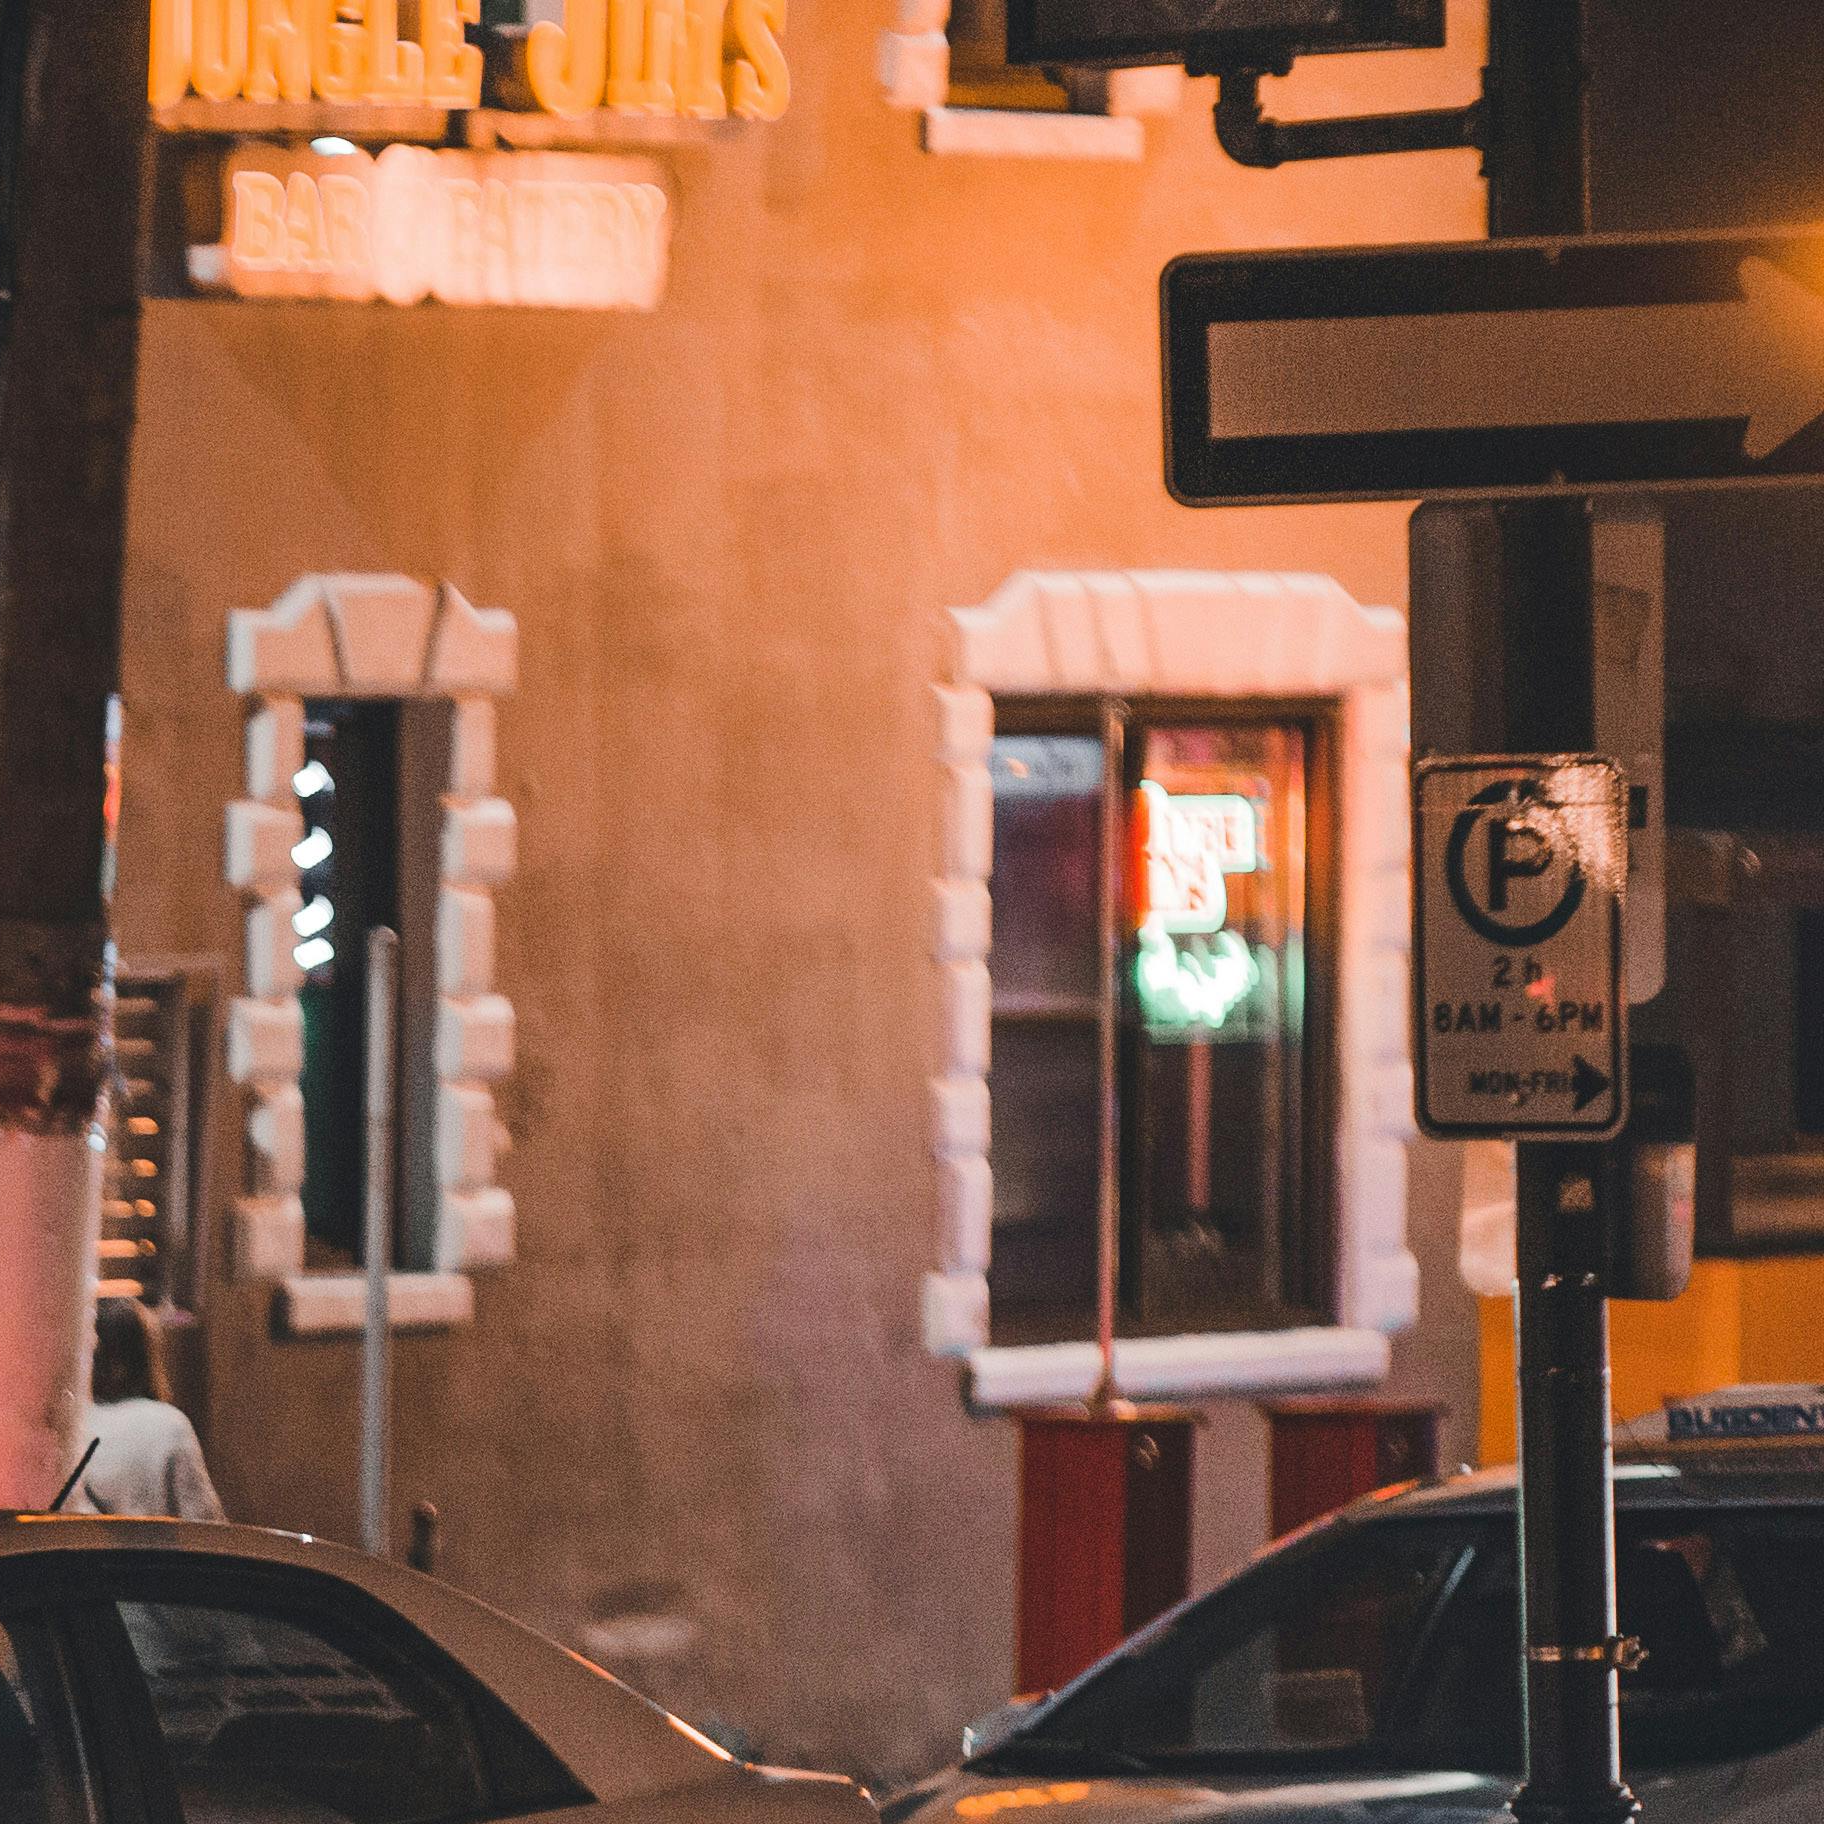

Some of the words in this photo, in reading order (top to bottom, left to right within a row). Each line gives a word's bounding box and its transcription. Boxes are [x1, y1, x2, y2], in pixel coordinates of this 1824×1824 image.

[1492, 957, 1511, 988] 2
[1434, 1002, 1501, 1034] 8AM
[1535, 1001, 1603, 1032] 6PM
